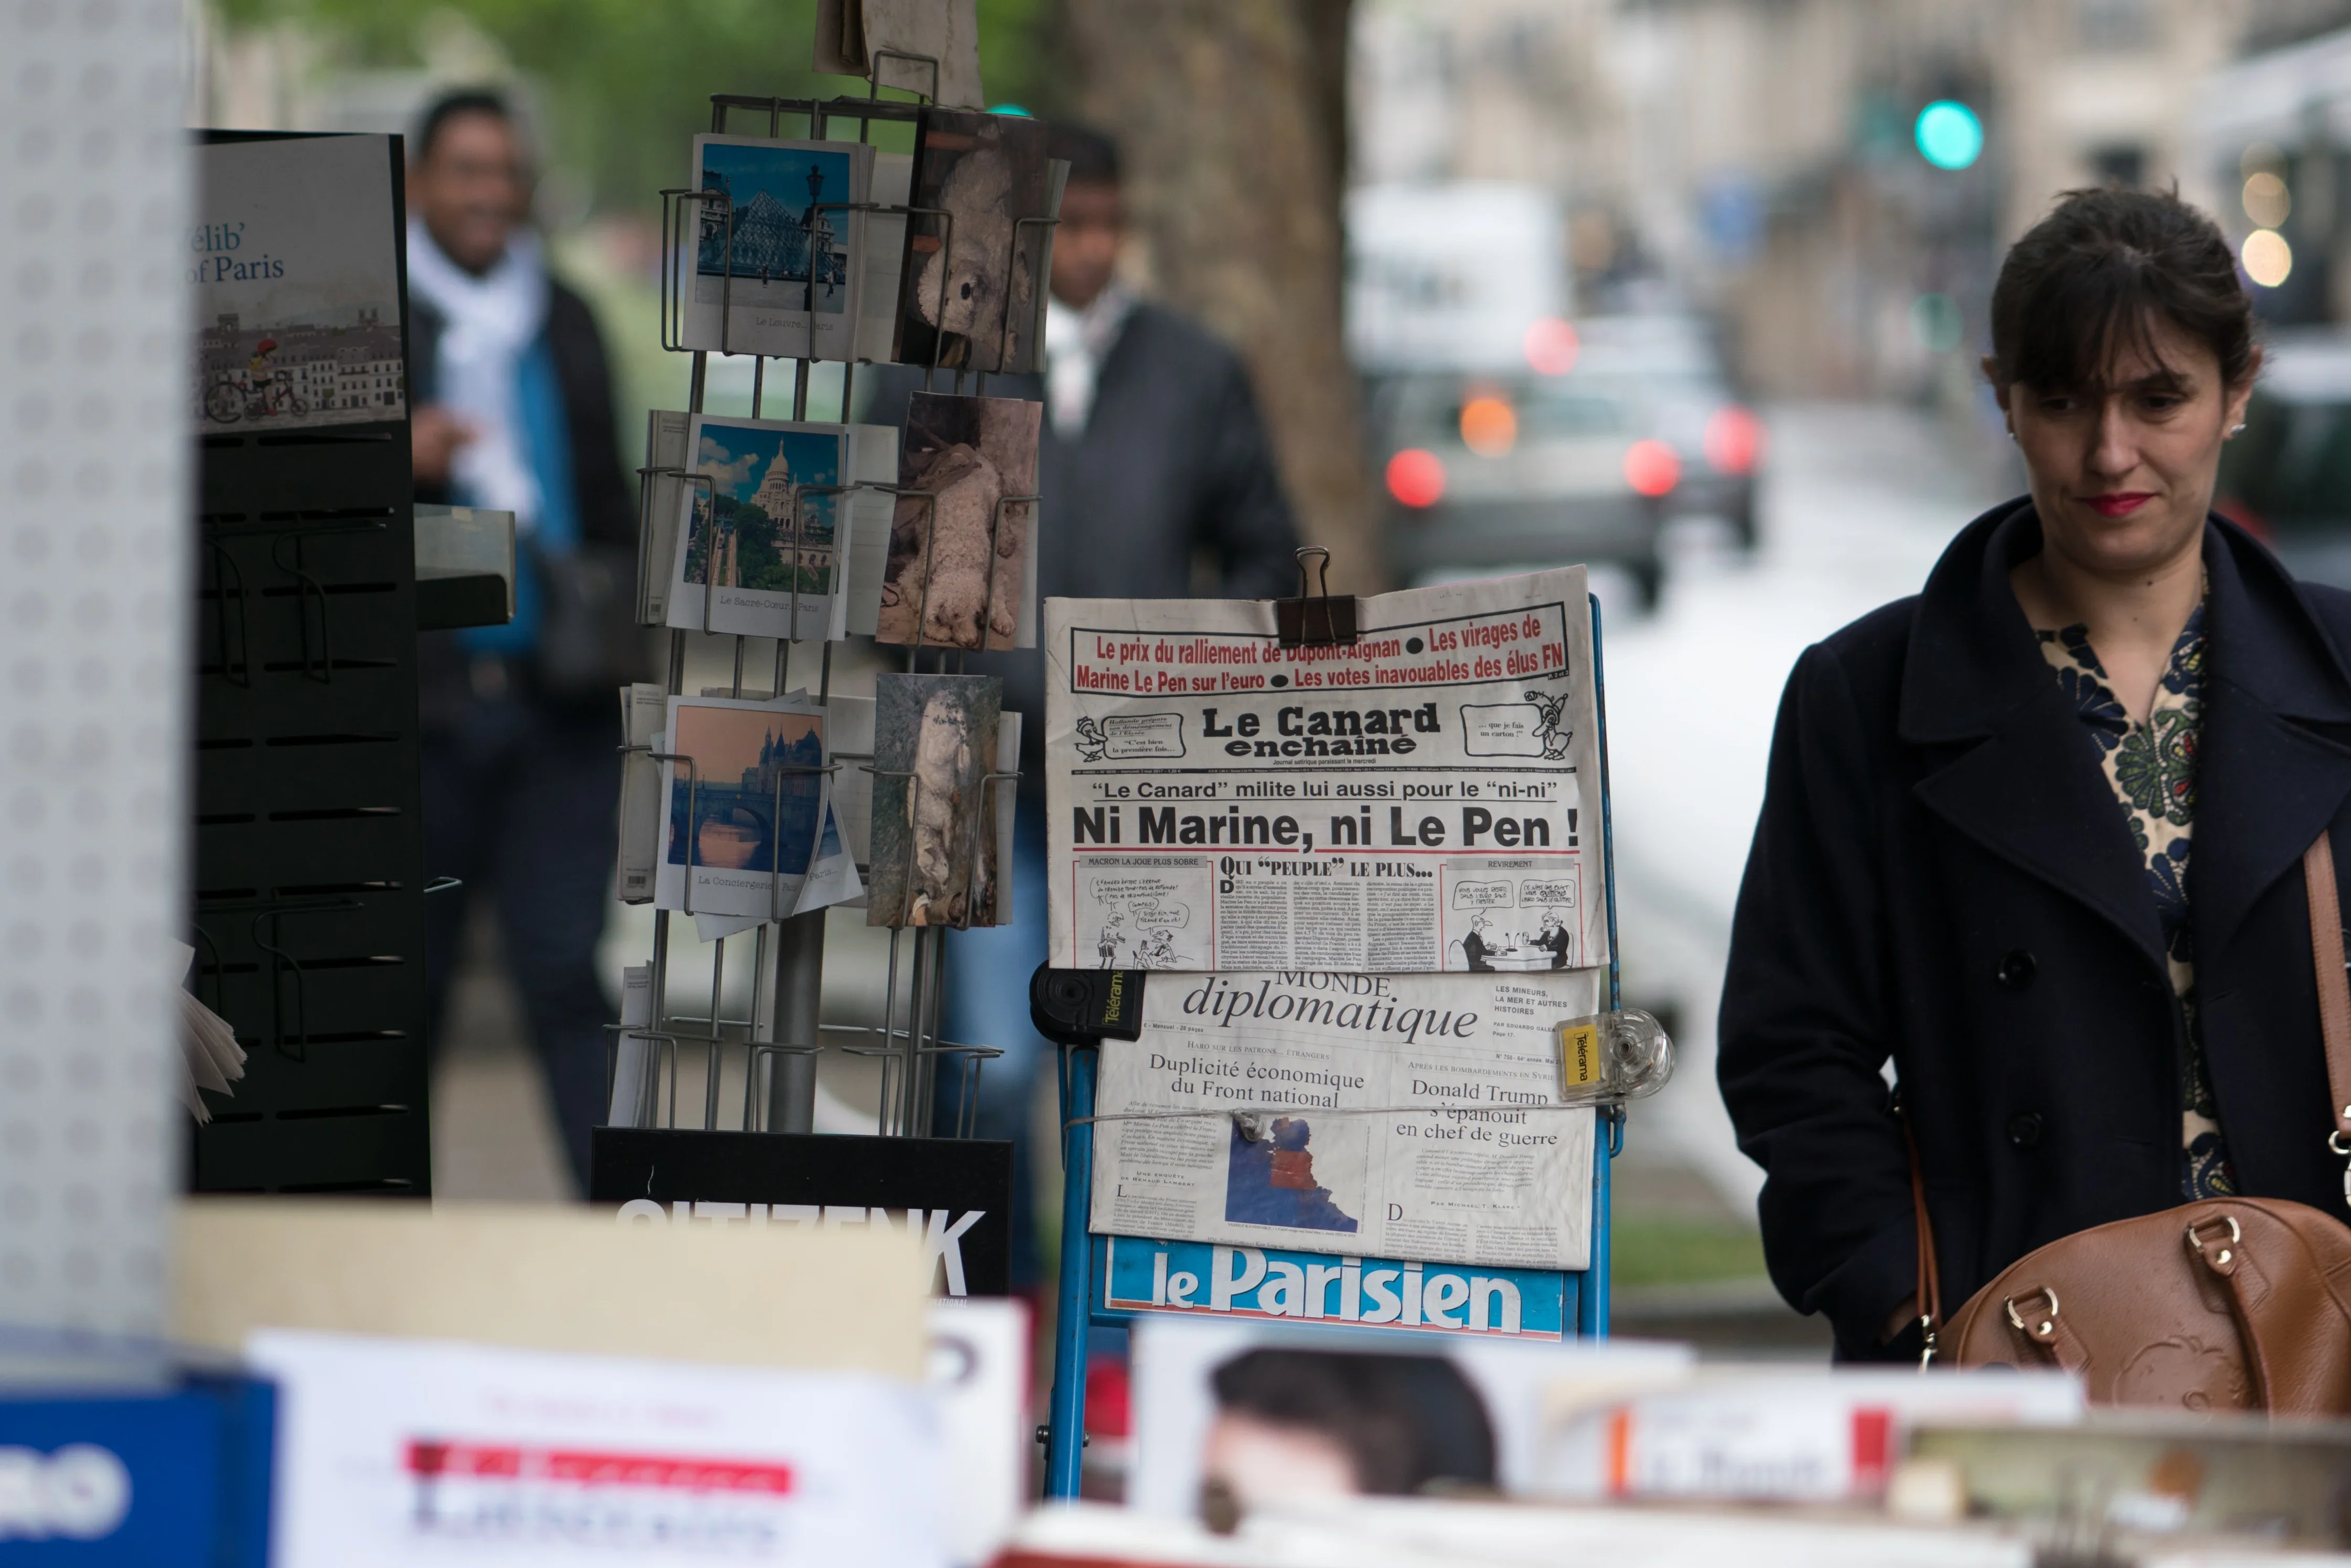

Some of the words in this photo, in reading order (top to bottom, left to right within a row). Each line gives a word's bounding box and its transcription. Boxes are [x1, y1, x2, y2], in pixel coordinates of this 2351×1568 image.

[191, 222, 245, 252] élib'
[213, 254, 284, 282] Paris
[756, 317, 766, 325] Le
[814, 322, 833, 330] aris
[720, 596, 732, 604] Le
[798, 603, 818, 612] Paris
[1097, 635, 1115, 659] Le
[1120, 637, 1150, 665] prix
[1155, 638, 1174, 664] du
[1178, 638, 1257, 665] ralliement
[1262, 641, 1281, 663] de
[1286, 637, 1401, 665] Dupont-Aignan
[1428, 627, 1457, 652] Les
[1461, 621, 1518, 648] virages
[1522, 614, 1541, 639] de
[1076, 665, 1129, 691] Marine
[1134, 669, 1153, 692] Le
[1158, 671, 1187, 692] Pen
[1192, 674, 1216, 692] sur
[1222, 671, 1265, 690] l'euro
[1295, 668, 1322, 687] Les
[1327, 667, 1371, 686] votes
[1375, 659, 1470, 683] inavouables
[1473, 655, 1502, 678] des
[1506, 648, 1538, 675] élus
[1541, 642, 1563, 668] FN
[1202, 708, 1260, 737] Le
[1278, 702, 1441, 737] Canard
[1224, 734, 1417, 757] enchaîné
[1093, 782, 1130, 798] "Le
[1137, 782, 1228, 798] Canard"
[1236, 781, 1296, 797] milite
[1303, 781, 1329, 797] lui
[1336, 781, 1395, 797] aussi
[1403, 782, 1454, 801] pour
[1461, 781, 1479, 797] le
[1073, 805, 1120, 844] Ni
[1138, 805, 1313, 854] Marine,
[1331, 805, 1372, 845] ni
[1390, 806, 1446, 847] Le
[1462, 806, 1551, 847] Pen
[1567, 808, 1579, 847] !
[698, 876, 710, 884] La
[713, 877, 773, 890] Conciergerie
[1350, 862, 1370, 877] LE
[1105, 970, 1124, 1023] Télérama
[1275, 971, 1391, 997] MONDE
[1512, 987, 1548, 997] MINEURS,
[1182, 976, 1478, 1045] diplomatique
[1494, 1006, 1534, 1015] HISTOIRES
[1286, 1048, 1330, 1060] ÉTRANGERS
[1577, 1033, 1588, 1081] Télérama
[1149, 1053, 1239, 1077] Duplicité
[1246, 1062, 1364, 1091] économique
[1451, 1065, 1518, 1078] BOMBARDEMENTS
[1171, 1077, 1194, 1093] du
[1202, 1081, 1254, 1101] Front
[1260, 1087, 1339, 1108] national
[1412, 1079, 1480, 1100] Donald
[1486, 1085, 1548, 1109] Trump
[1396, 1124, 1418, 1137] en
[1424, 1124, 1468, 1140] chef
[1471, 1126, 1492, 1141] de
[1498, 1132, 1558, 1147] guerre
[1152, 1252, 1199, 1309] le
[1210, 1245, 1522, 1335] Parisien
